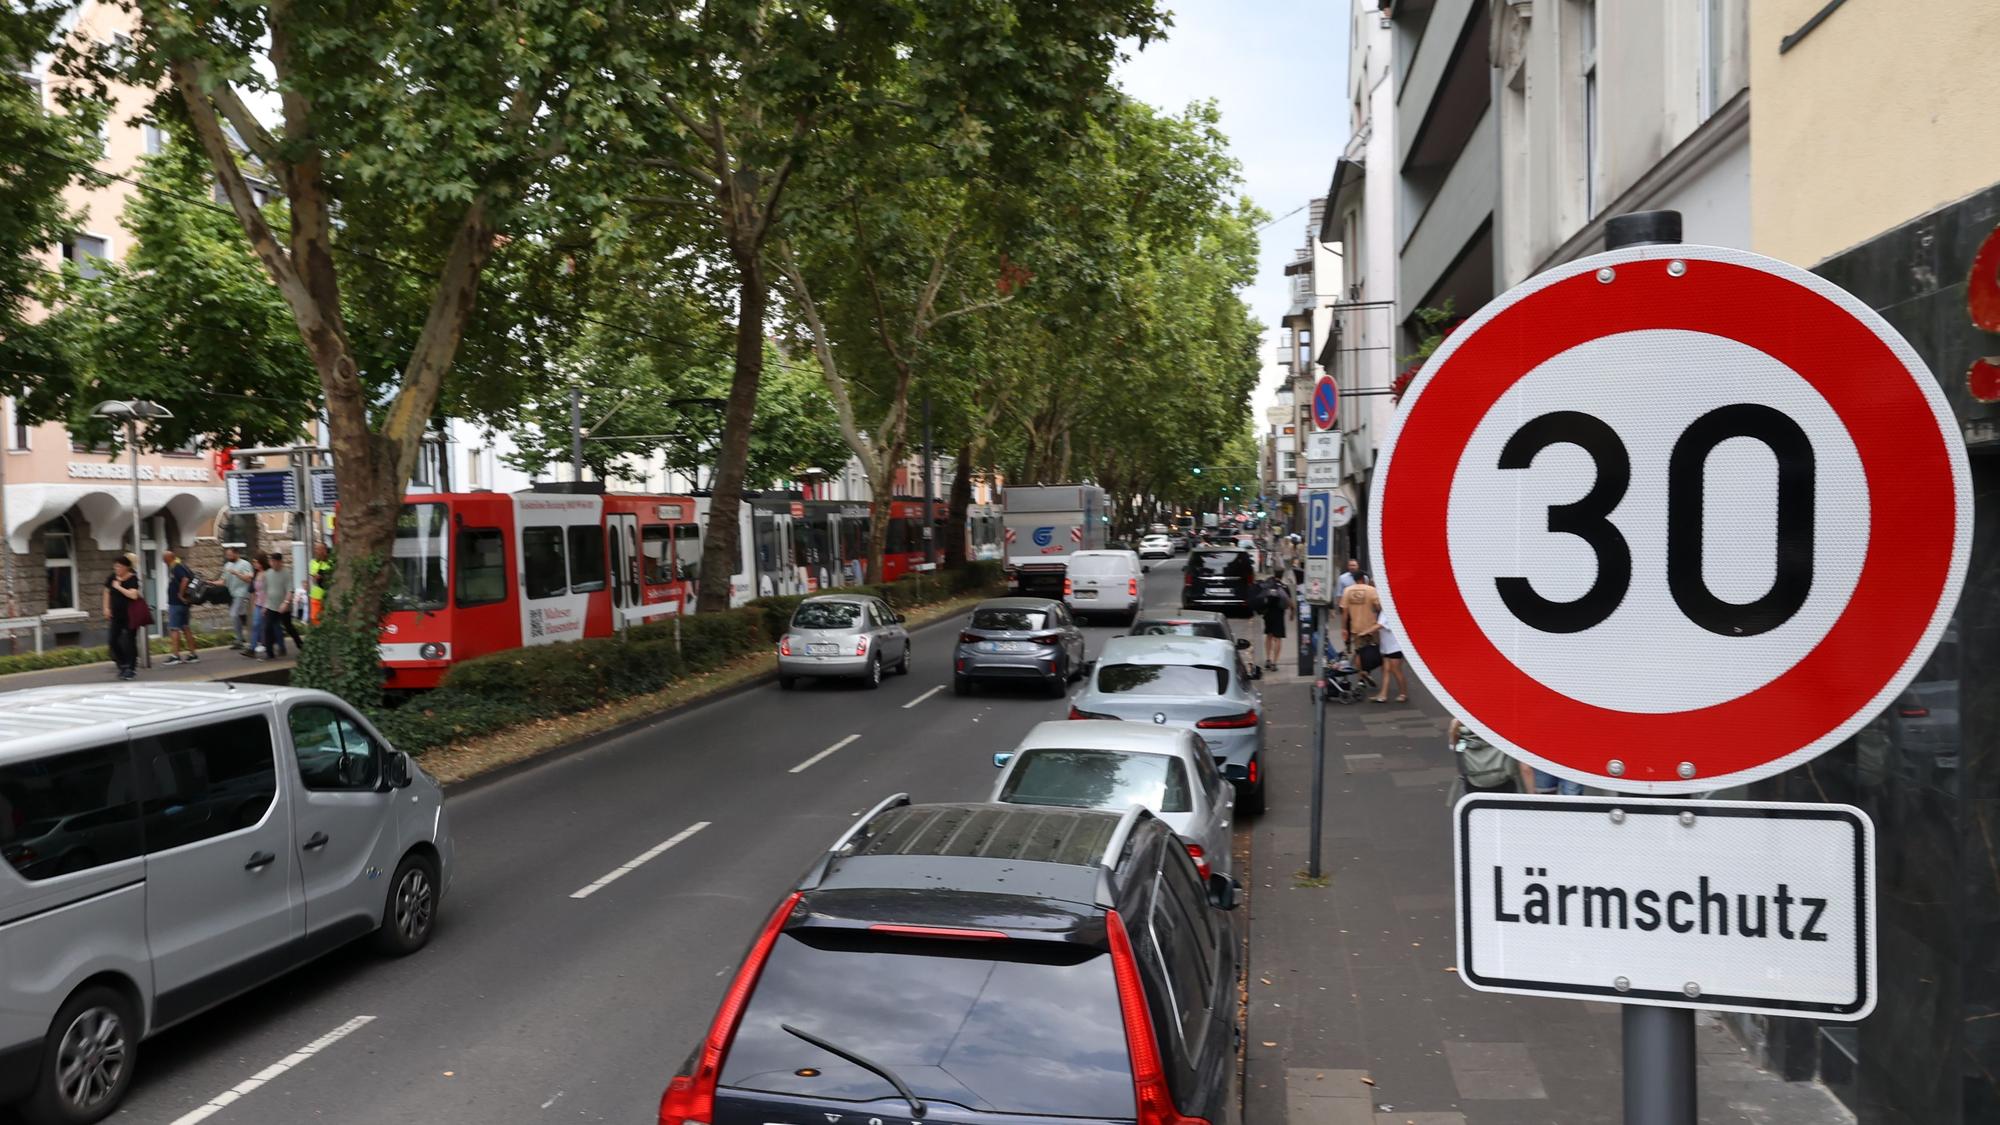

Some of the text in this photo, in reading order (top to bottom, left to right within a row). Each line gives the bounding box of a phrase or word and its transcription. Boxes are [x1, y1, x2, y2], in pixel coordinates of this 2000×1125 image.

[1311, 498, 1326, 547] P
[1494, 402, 1816, 638] 30
[1494, 865, 1828, 942] Lärmschutz
